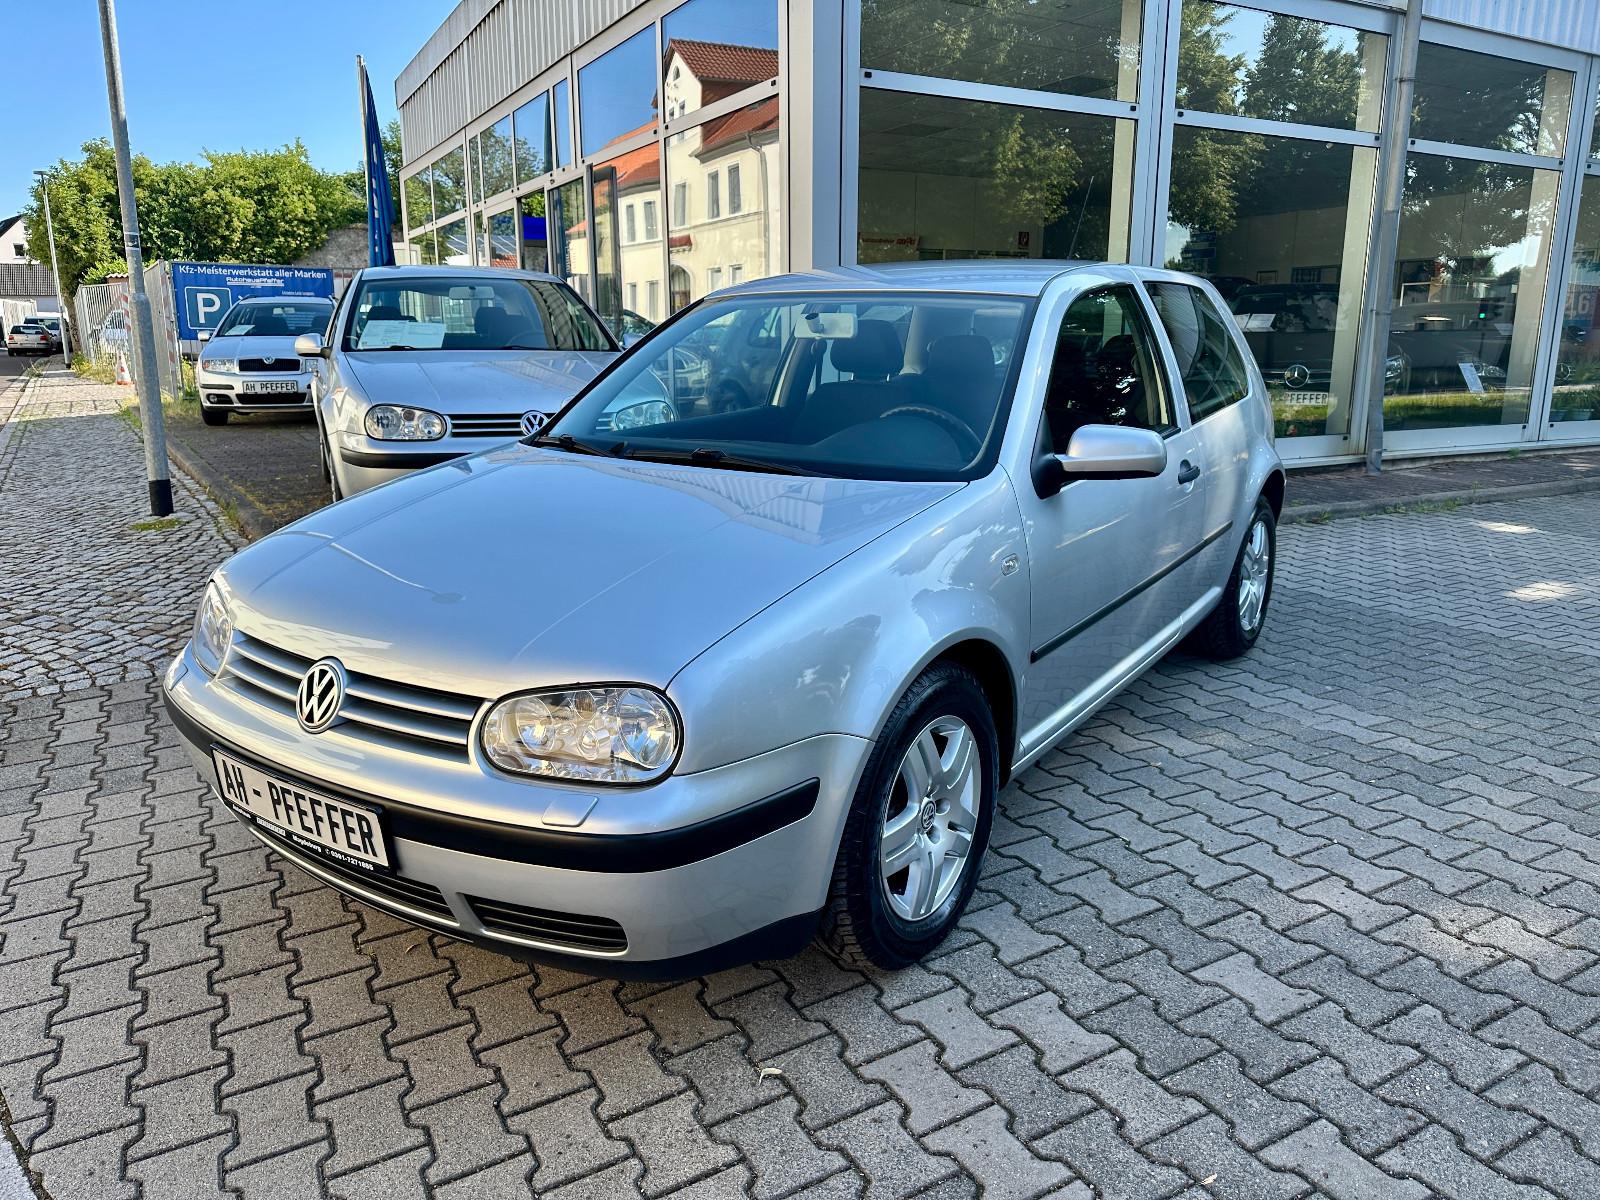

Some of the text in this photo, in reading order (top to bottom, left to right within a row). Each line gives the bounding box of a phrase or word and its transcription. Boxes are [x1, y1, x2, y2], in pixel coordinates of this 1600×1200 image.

[179, 265, 327, 279] Kfz-Meisterwerkstatt aller Marken
[197, 293, 221, 323] P
[245, 382, 296, 392] AH PFEFFER
[222, 759, 250, 806] AH
[266, 780, 378, 858] PFEFFER
